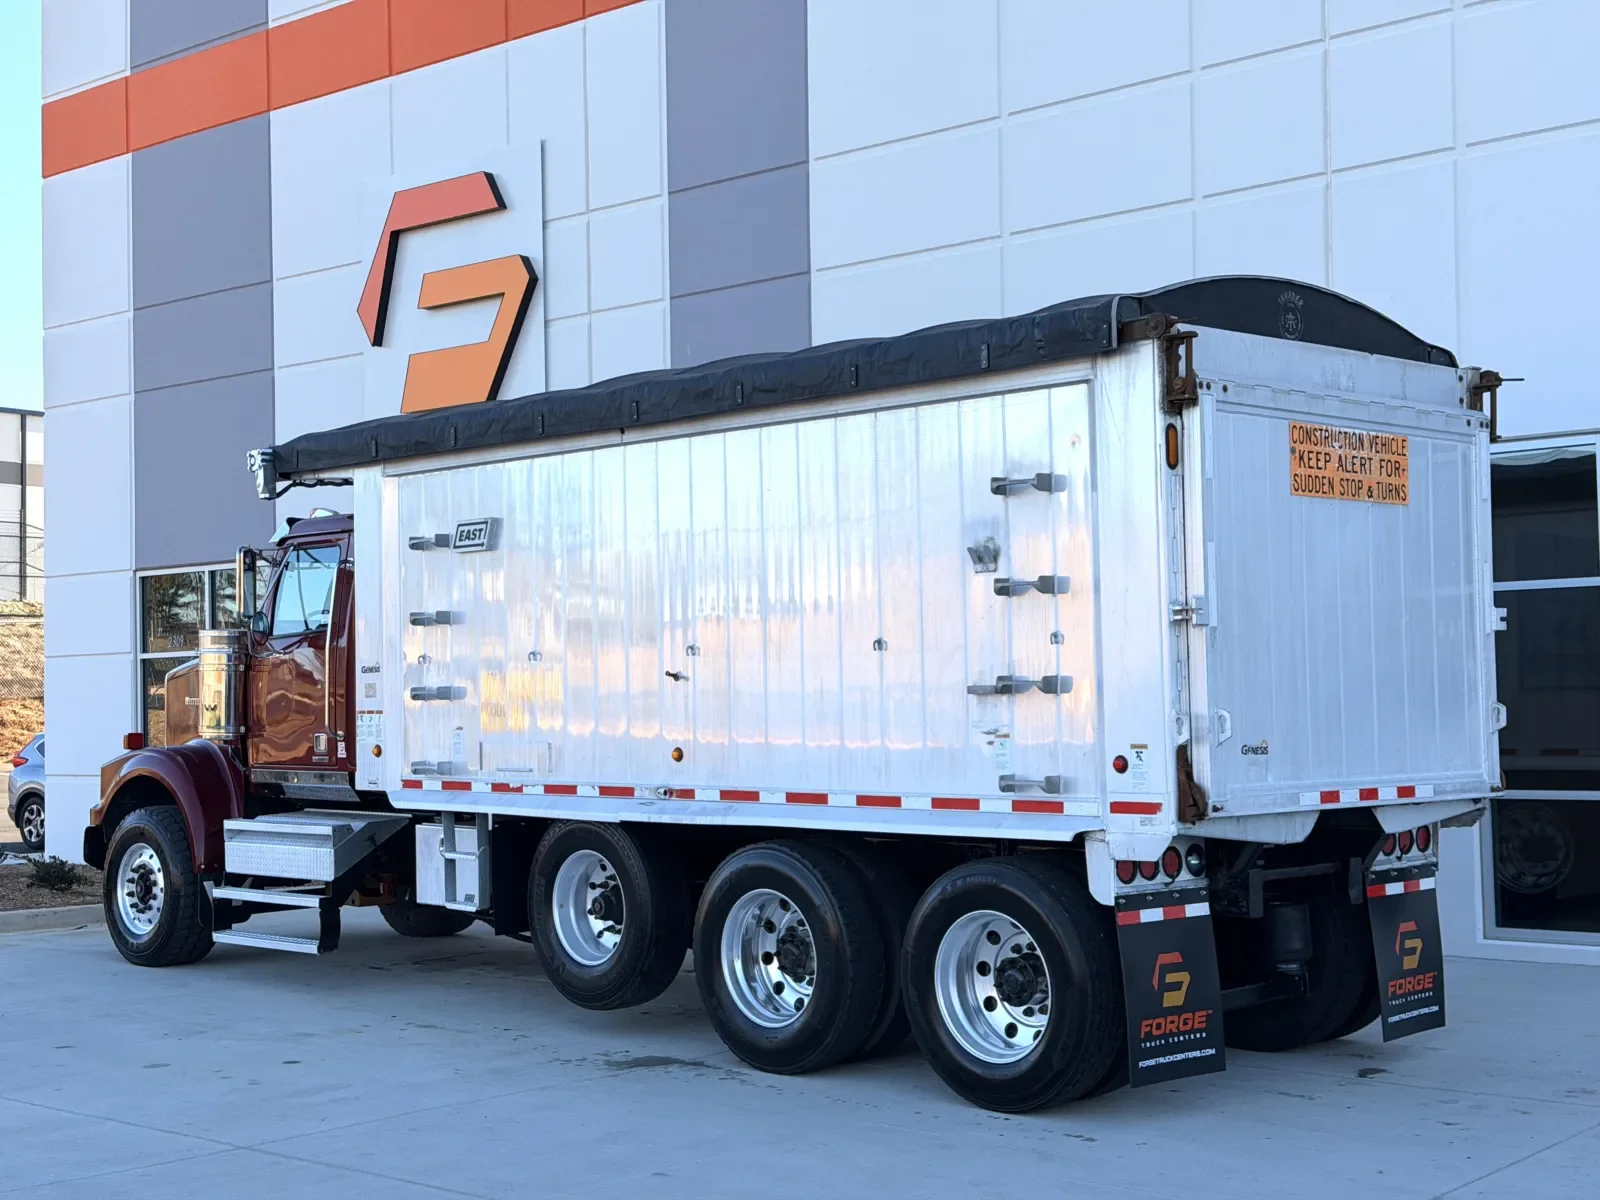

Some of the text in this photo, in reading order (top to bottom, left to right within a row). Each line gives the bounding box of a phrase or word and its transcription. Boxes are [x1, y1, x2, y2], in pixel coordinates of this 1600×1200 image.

[1291, 424, 1407, 457] CONSTRUCTION VEHICLE
[1298, 449, 1402, 479] KEEP ALERT FOR
[1293, 473, 1407, 502] SUDDEN STOP & TURNS
[458, 528, 485, 542] EAST
[1388, 972, 1434, 998] FORGE
[1140, 1010, 1208, 1039] FORGE
[1168, 1032, 1207, 1044] CENTERS
